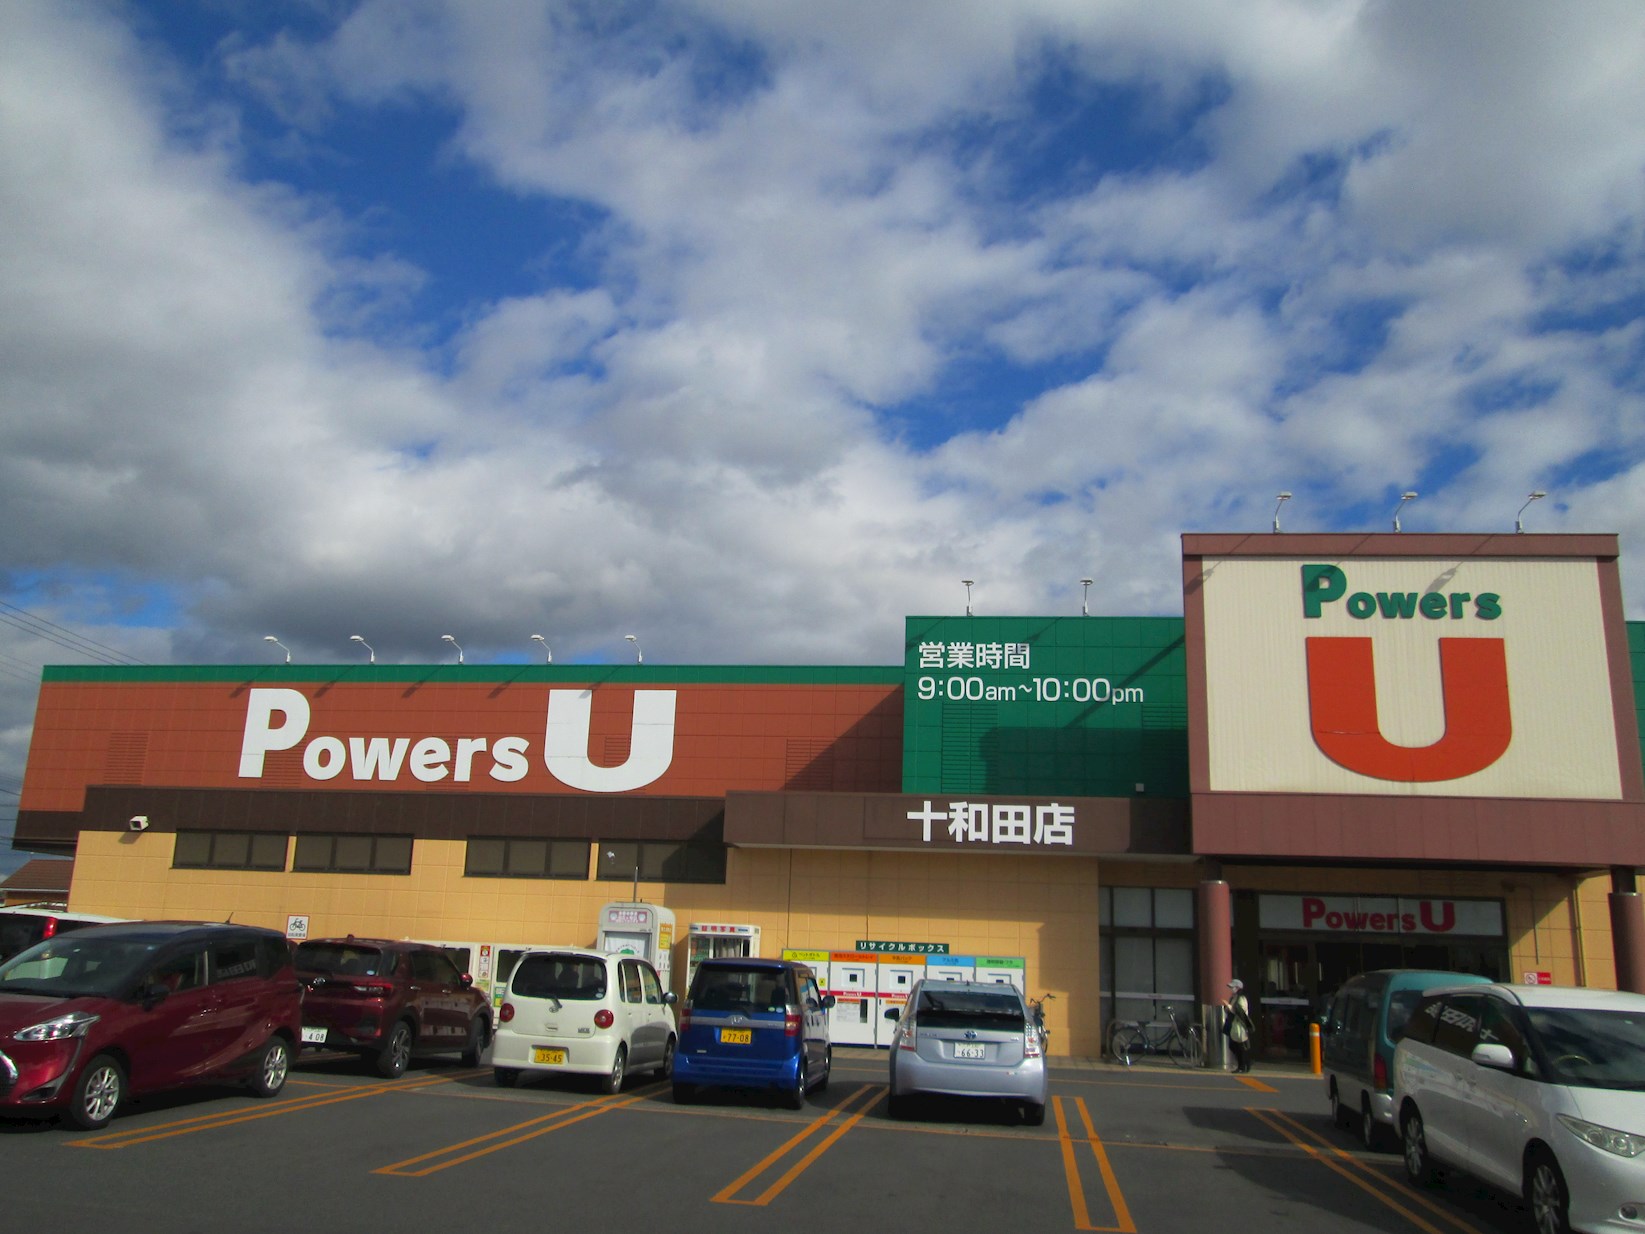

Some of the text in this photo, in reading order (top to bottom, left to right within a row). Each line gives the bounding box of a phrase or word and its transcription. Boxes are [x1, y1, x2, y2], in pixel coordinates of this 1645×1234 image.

[1301, 564, 1503, 620] Powers
[918, 641, 1031, 670] 営業時間
[1305, 637, 1513, 783] U
[238, 688, 677, 792] Powers U
[906, 800, 1075, 846] 十和田店
[1302, 897, 1456, 933] Powers U
[860, 941, 945, 953] リサイクルボックス
